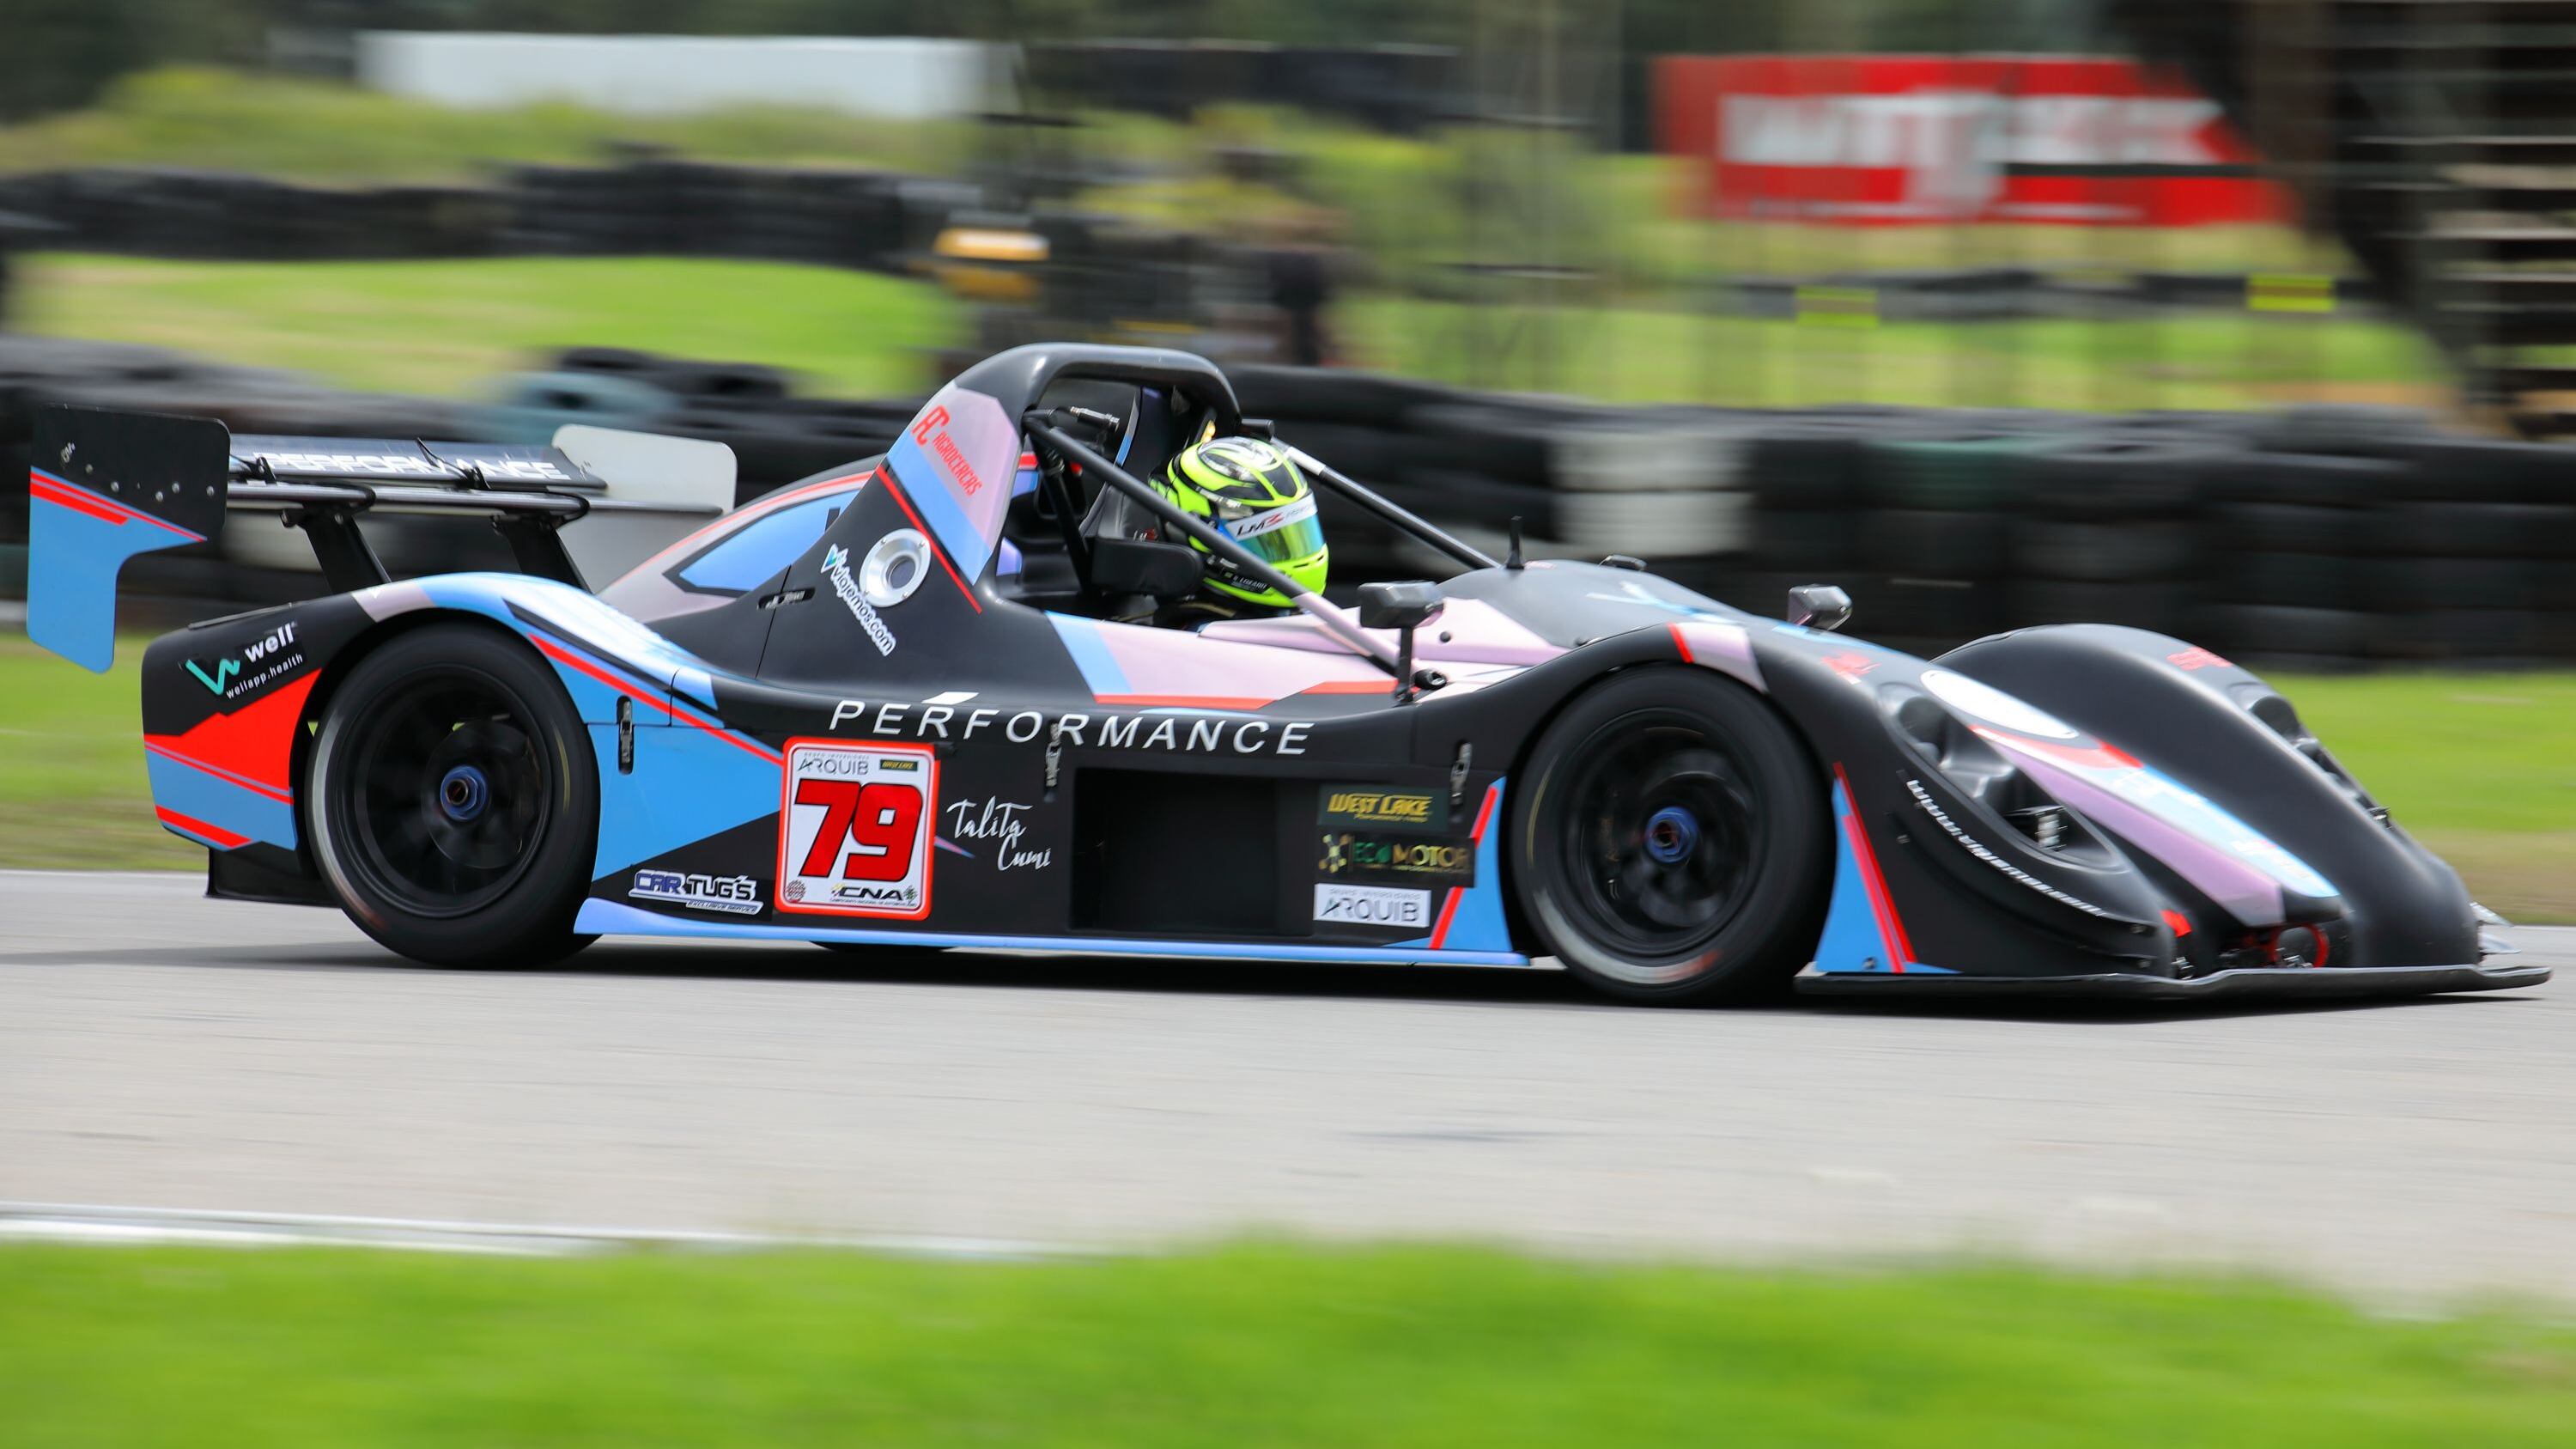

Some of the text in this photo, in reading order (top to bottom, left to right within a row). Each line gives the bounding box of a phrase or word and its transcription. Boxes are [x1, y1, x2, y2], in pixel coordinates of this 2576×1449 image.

[245, 623, 295, 663] well
[226, 653, 303, 699] wellapp.health
[829, 699, 1315, 755] PERFORMANCE
[797, 758, 870, 776] ARQUIB
[1327, 793, 1433, 816] WEST LAKE
[794, 778, 923, 882] 79
[997, 833, 1051, 871] Cumi
[634, 869, 684, 895] CAR
[839, 886, 903, 901] CNA
[1321, 897, 1419, 922] ARQUIB
